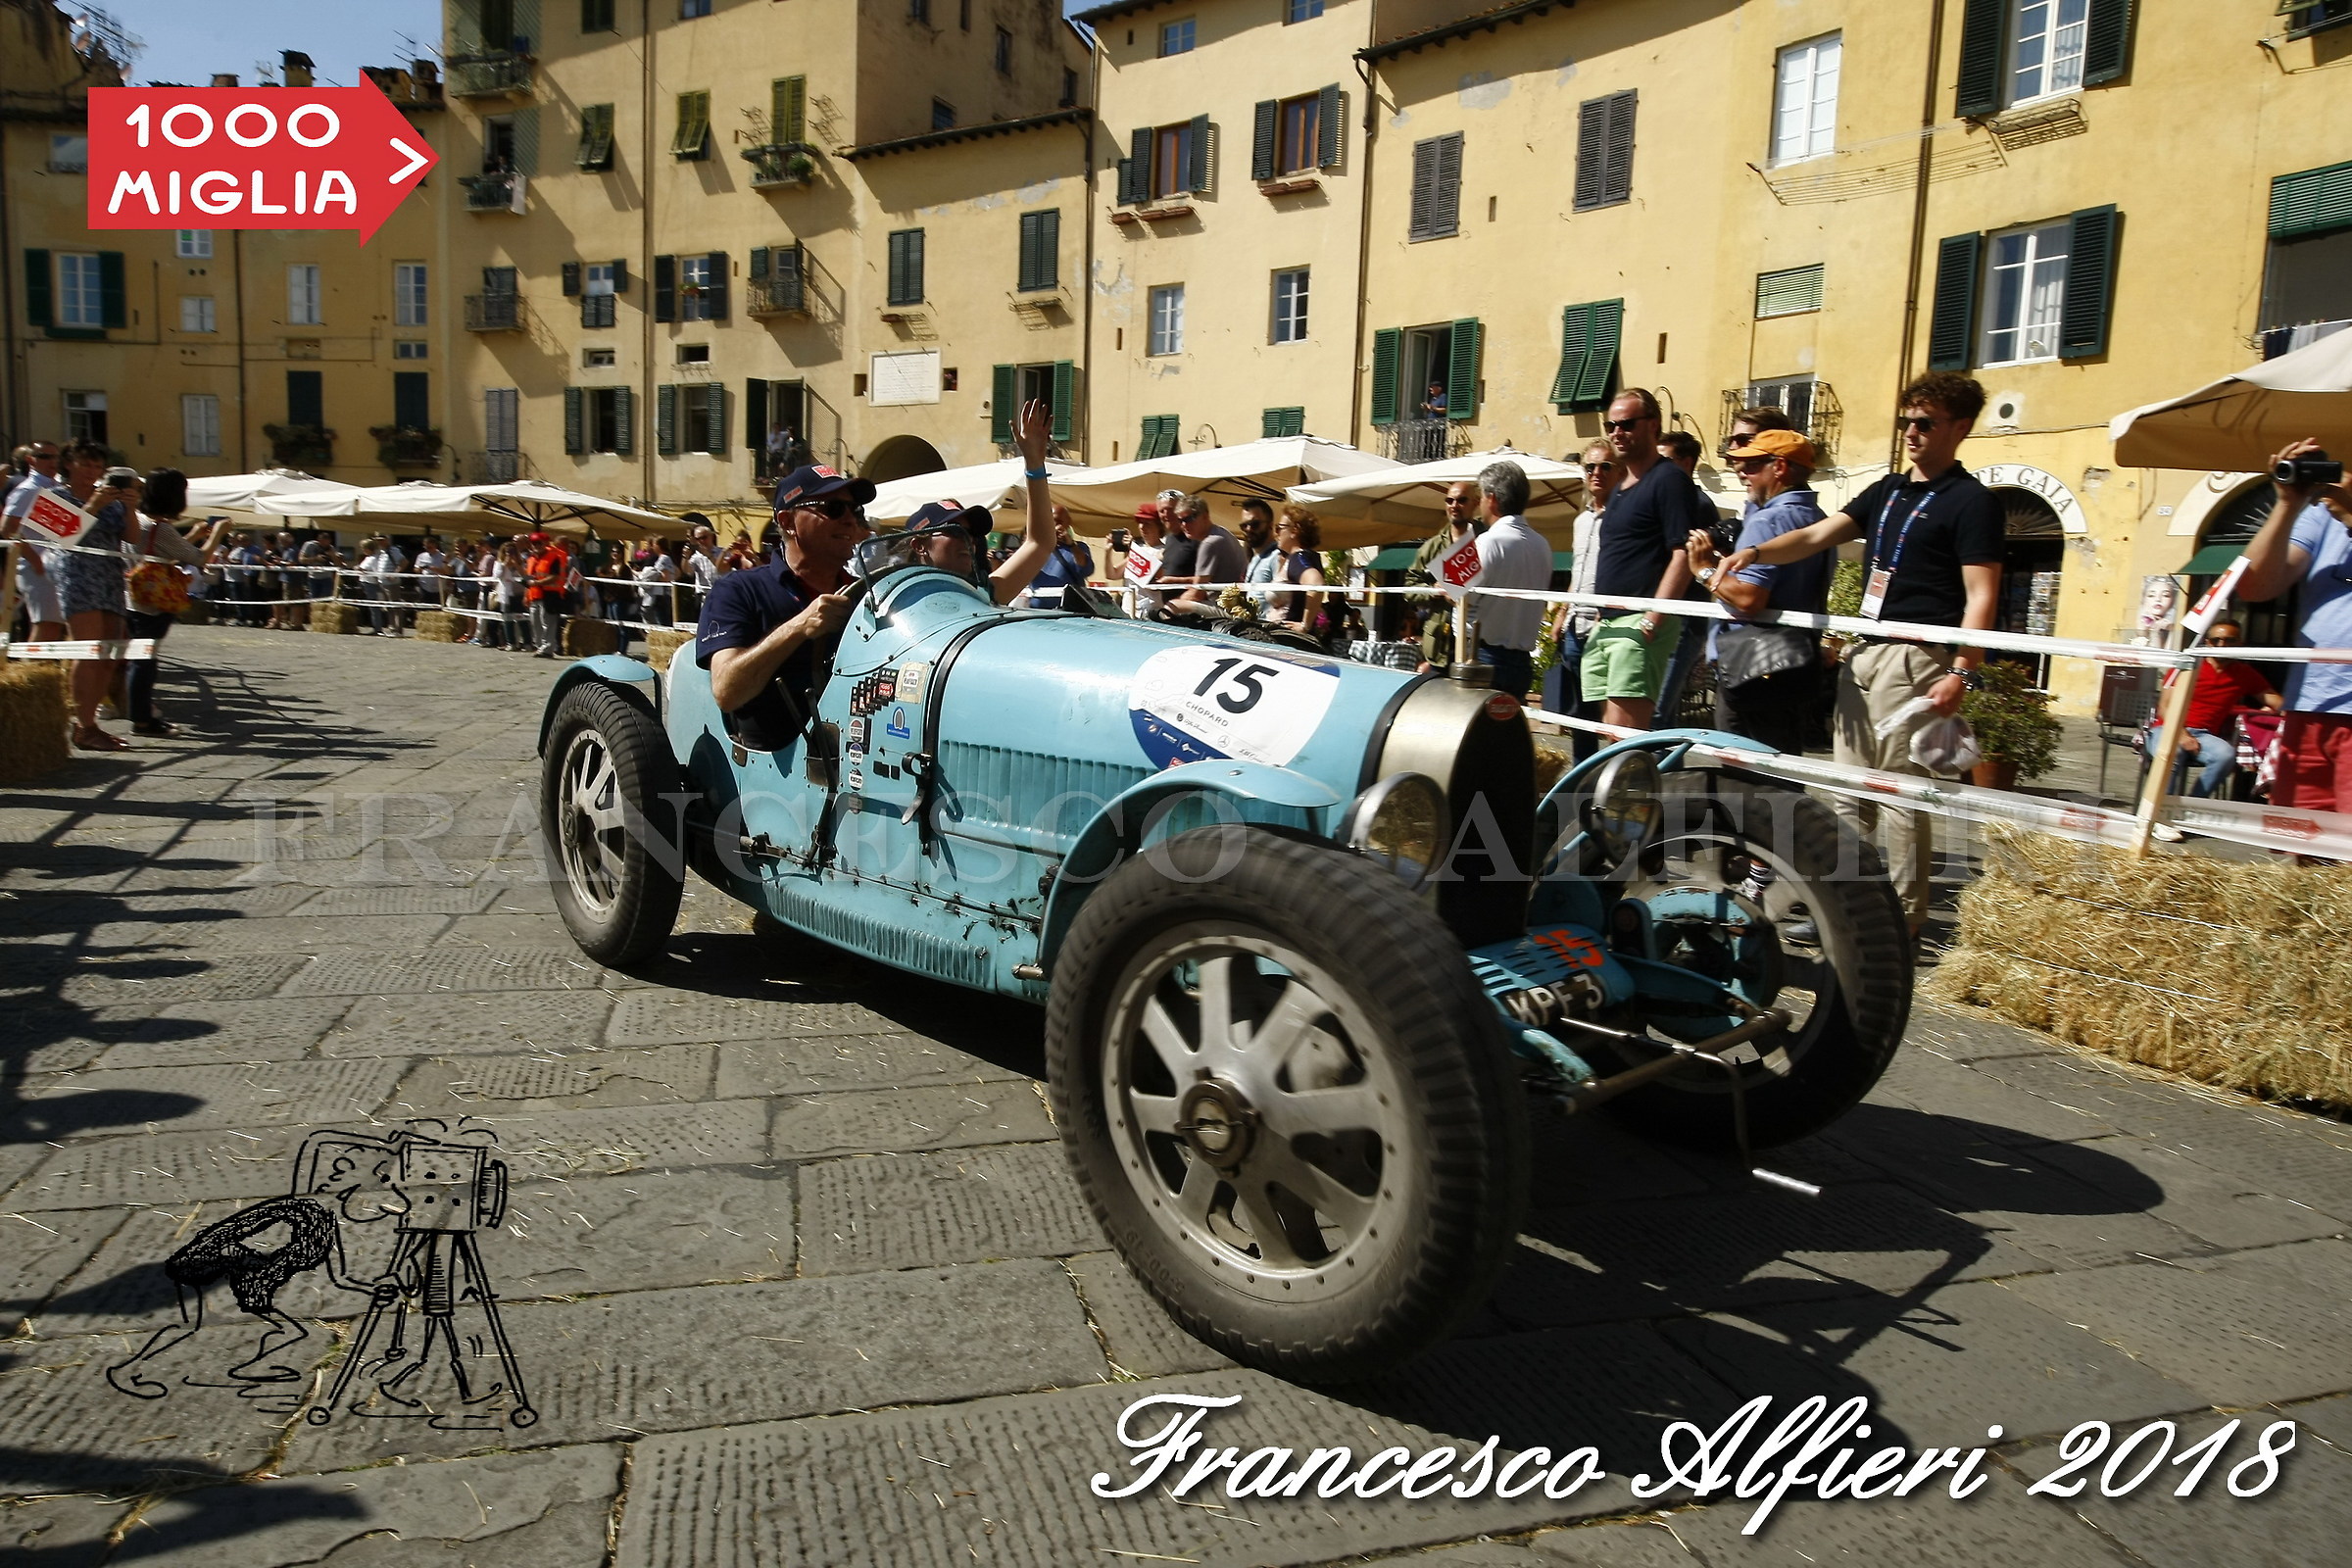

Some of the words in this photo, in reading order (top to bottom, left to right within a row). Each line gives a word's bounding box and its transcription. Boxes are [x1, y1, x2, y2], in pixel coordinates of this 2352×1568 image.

[2017, 467, 2075, 514] GAIA
[1450, 540, 1477, 568] 100
[1457, 557, 1481, 582] MIG
[1193, 658, 1280, 714] 15
[1185, 700, 1229, 728] CHOPARD
[1533, 929, 1604, 969] 15
